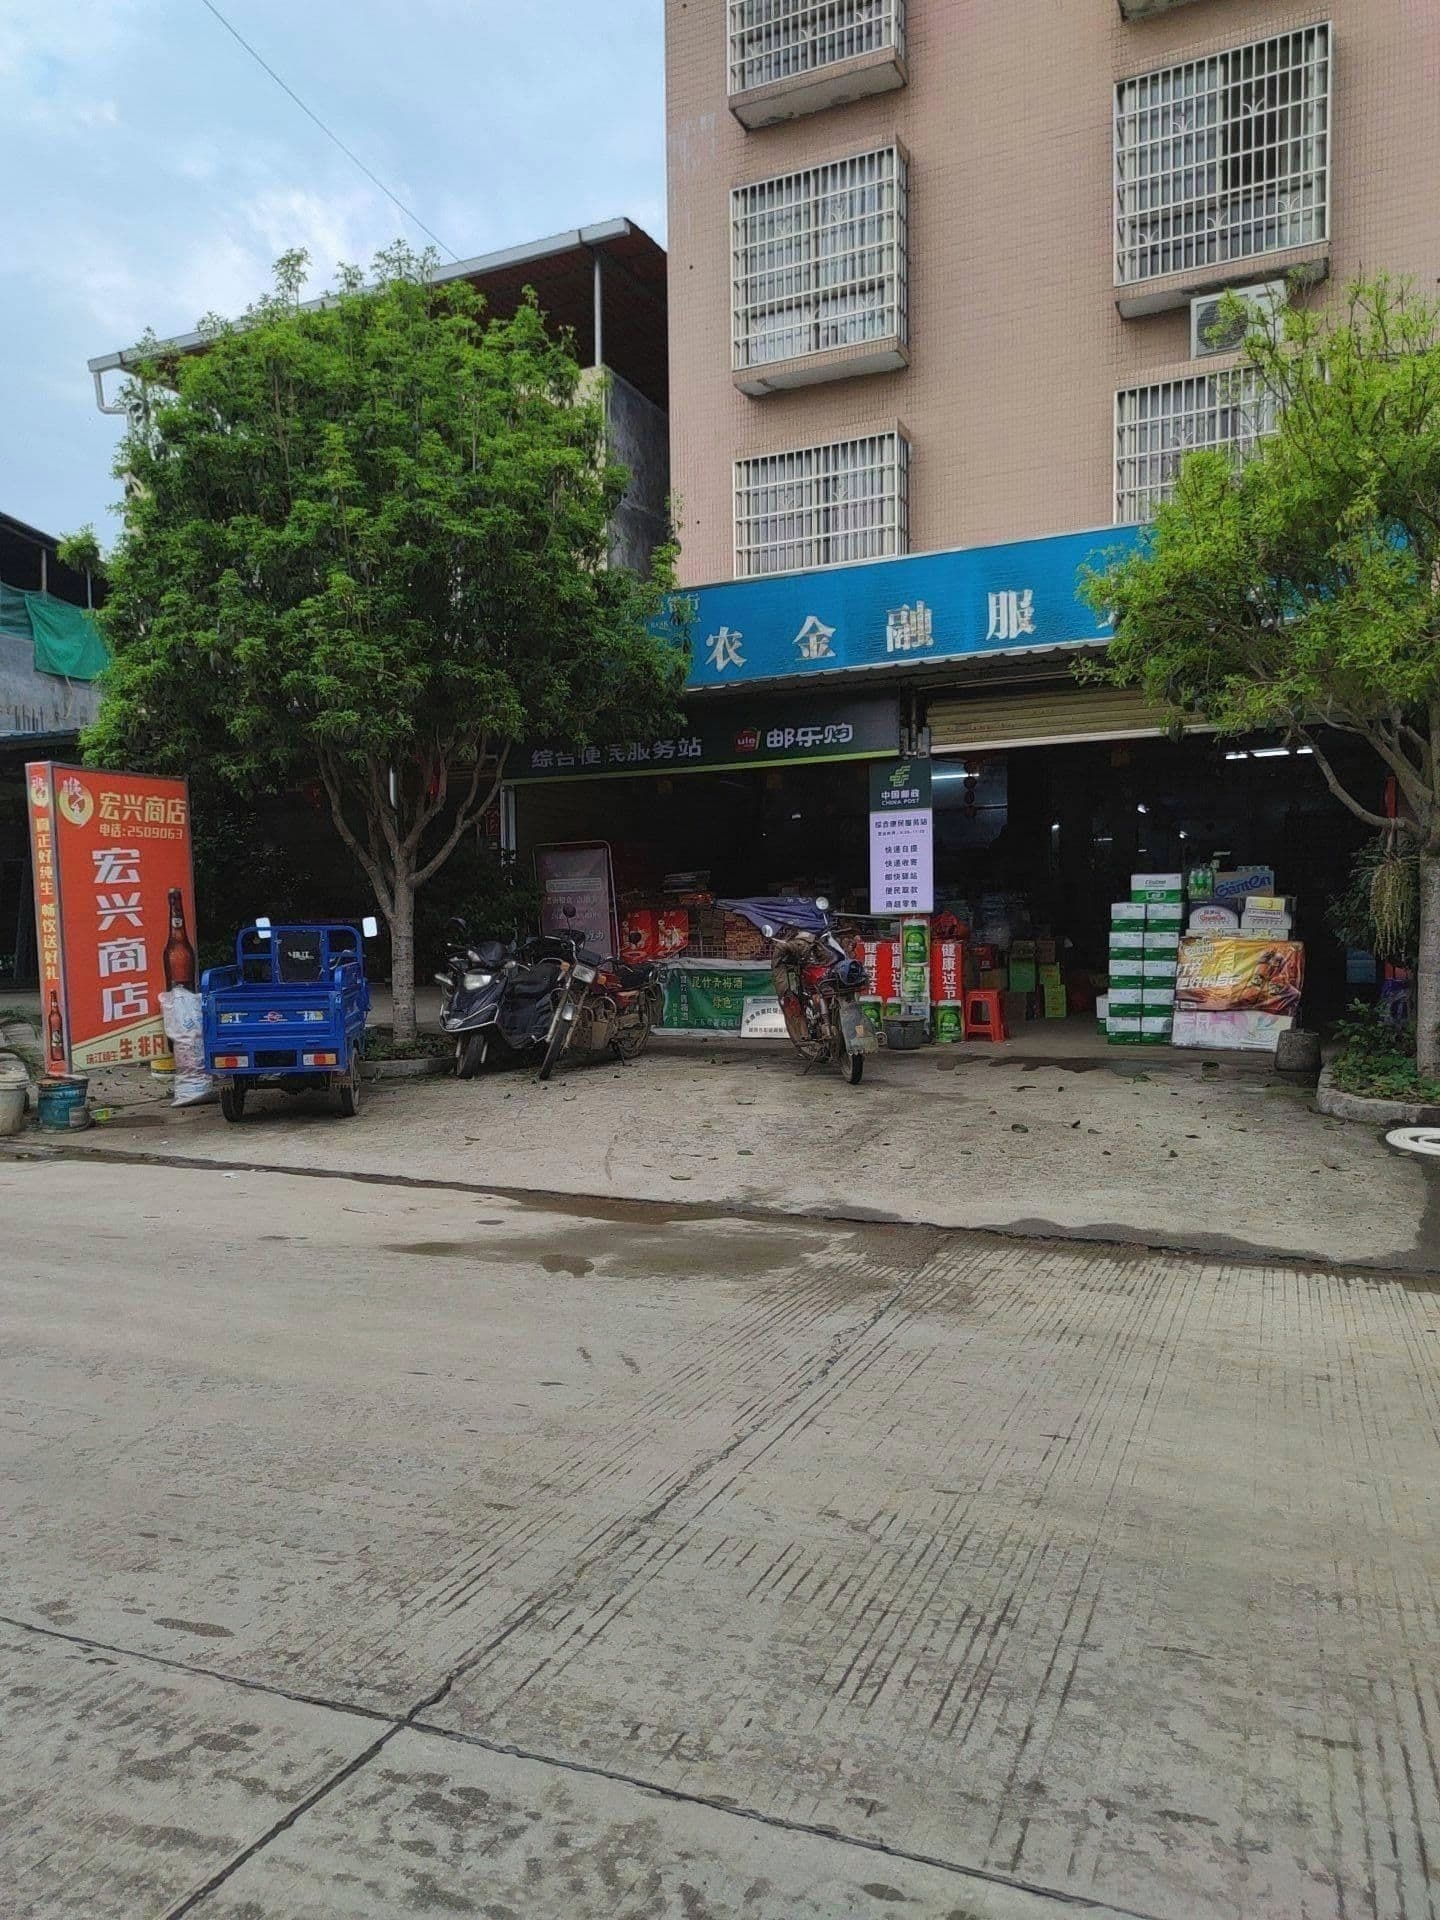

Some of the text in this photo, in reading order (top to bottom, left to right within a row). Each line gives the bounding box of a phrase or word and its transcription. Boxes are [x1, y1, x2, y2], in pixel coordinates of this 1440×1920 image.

[704, 588, 1115, 673] 农金融服
[766, 723, 854, 749] 邮乐购
[99, 792, 186, 825] 宏兴商店
[881, 789, 920, 800] 中国邮政
[884, 845, 918, 854] 快递自提
[92, 847, 149, 1023] 宏兴商店
[942, 943, 957, 999] 健康过节
